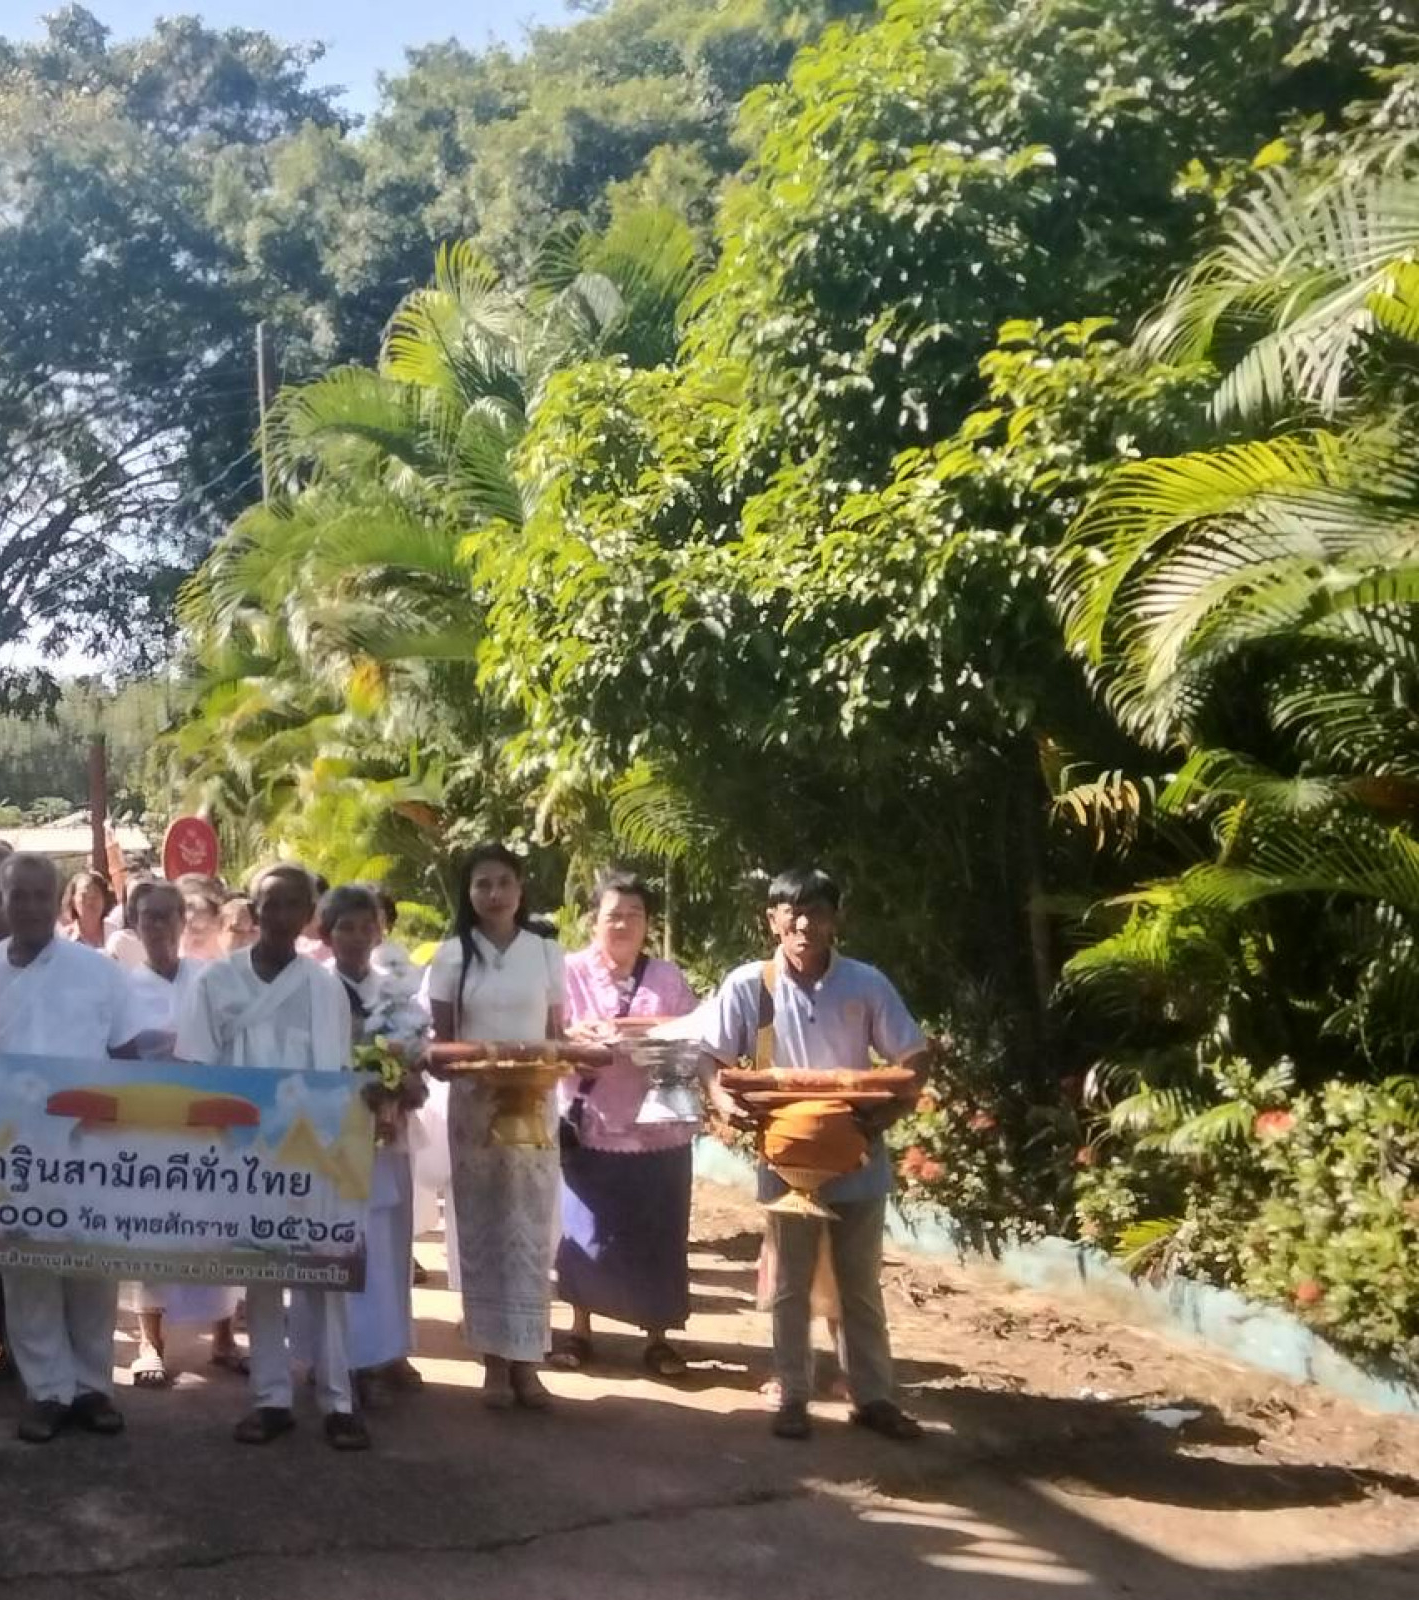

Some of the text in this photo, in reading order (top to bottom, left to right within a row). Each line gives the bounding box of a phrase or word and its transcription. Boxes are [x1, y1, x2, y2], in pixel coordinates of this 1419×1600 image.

[79, 1206, 106, 1230] วัด
[115, 1212, 239, 1242] พุทธศักราช
[250, 1214, 356, 1243] ๒๕๖๘
